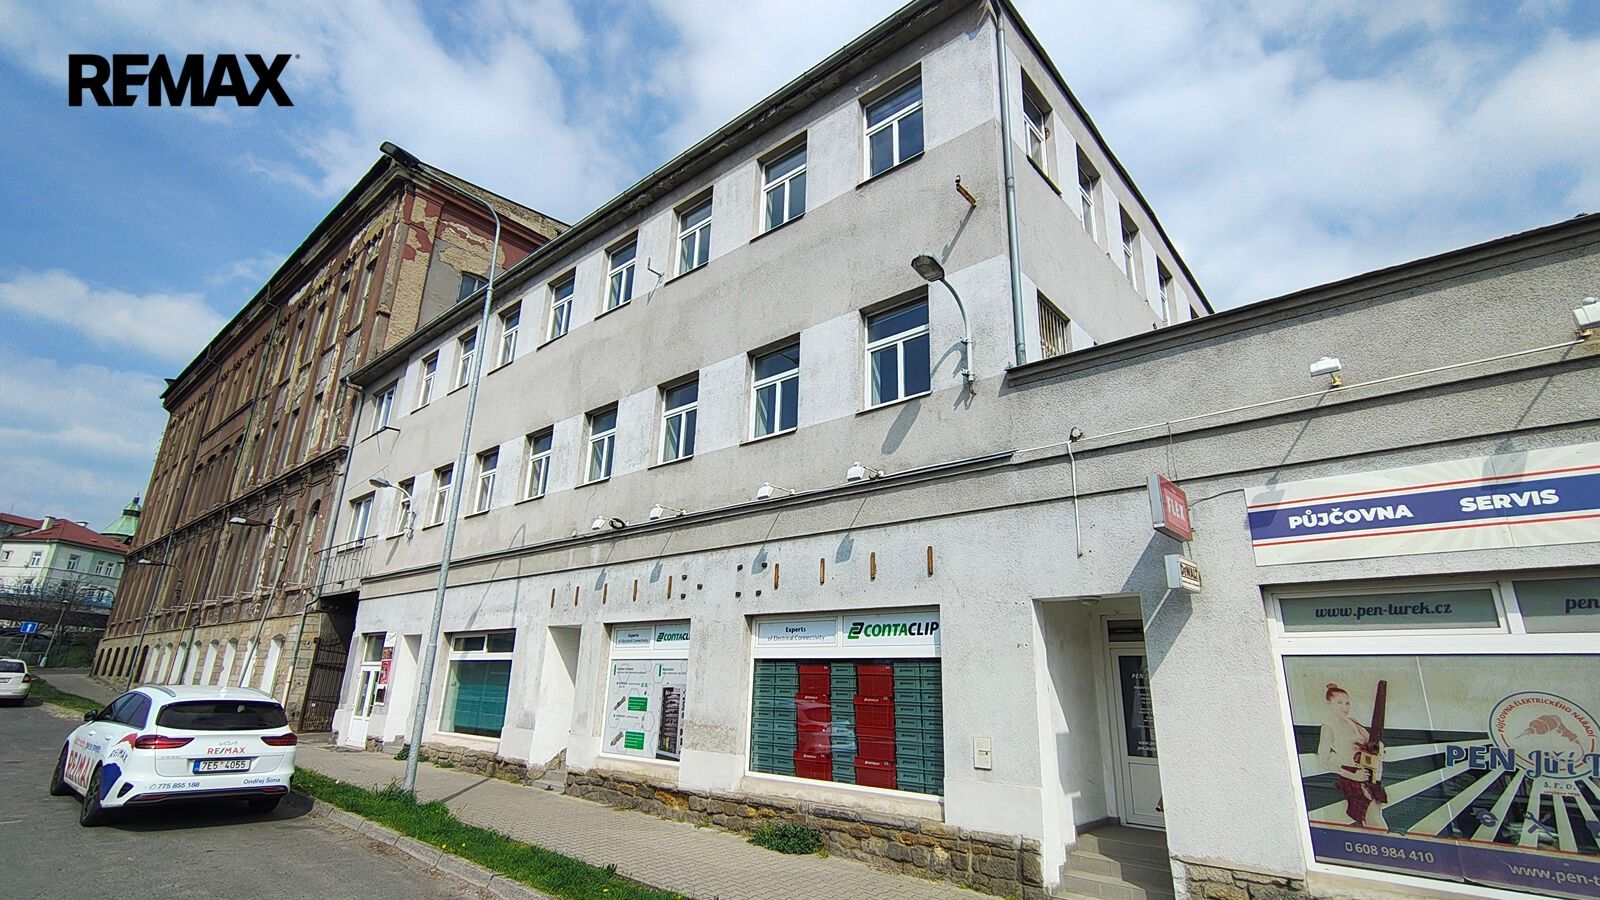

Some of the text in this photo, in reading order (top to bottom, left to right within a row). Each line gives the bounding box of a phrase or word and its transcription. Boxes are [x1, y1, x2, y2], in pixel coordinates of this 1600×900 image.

[1167, 495, 1186, 522] FLEX
[1288, 488, 1560, 529] PŮJČOVNA SERVIS
[1315, 601, 1452, 620] www.pen-turek.cz
[785, 626, 806, 634] Experts
[794, 634, 825, 642] Connectivity
[1514, 697, 1572, 713] ELEKTRICKÉHO
[207, 747, 246, 755] RE/MAX
[1446, 745, 1515, 771] PEN
[202, 760, 246, 770] 7E5 4055
[1355, 842, 1434, 863] 608 984 410
